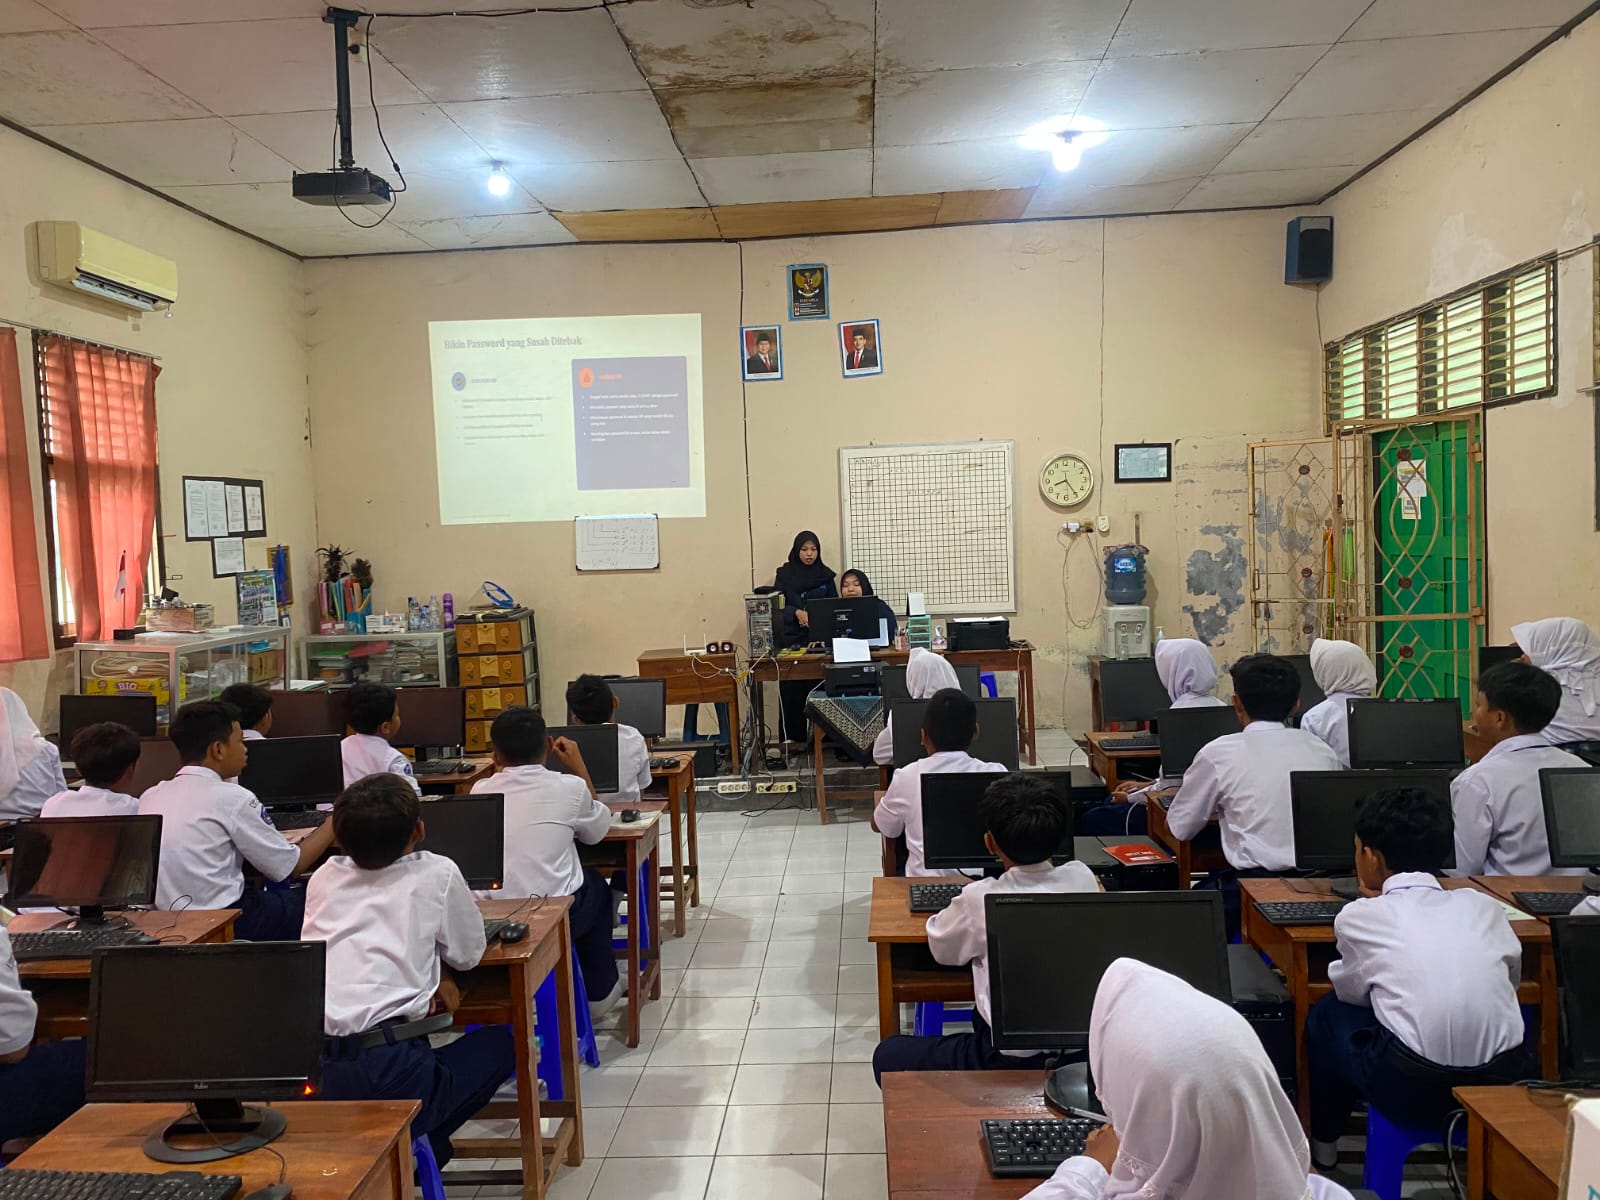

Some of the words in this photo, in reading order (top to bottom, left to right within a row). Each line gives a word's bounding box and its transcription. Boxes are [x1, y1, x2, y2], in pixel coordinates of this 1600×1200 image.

[467, 338, 505, 349] Password
[506, 340, 525, 350] yang
[527, 337, 550, 347] Susah
[551, 336, 582, 346] Ditebak
